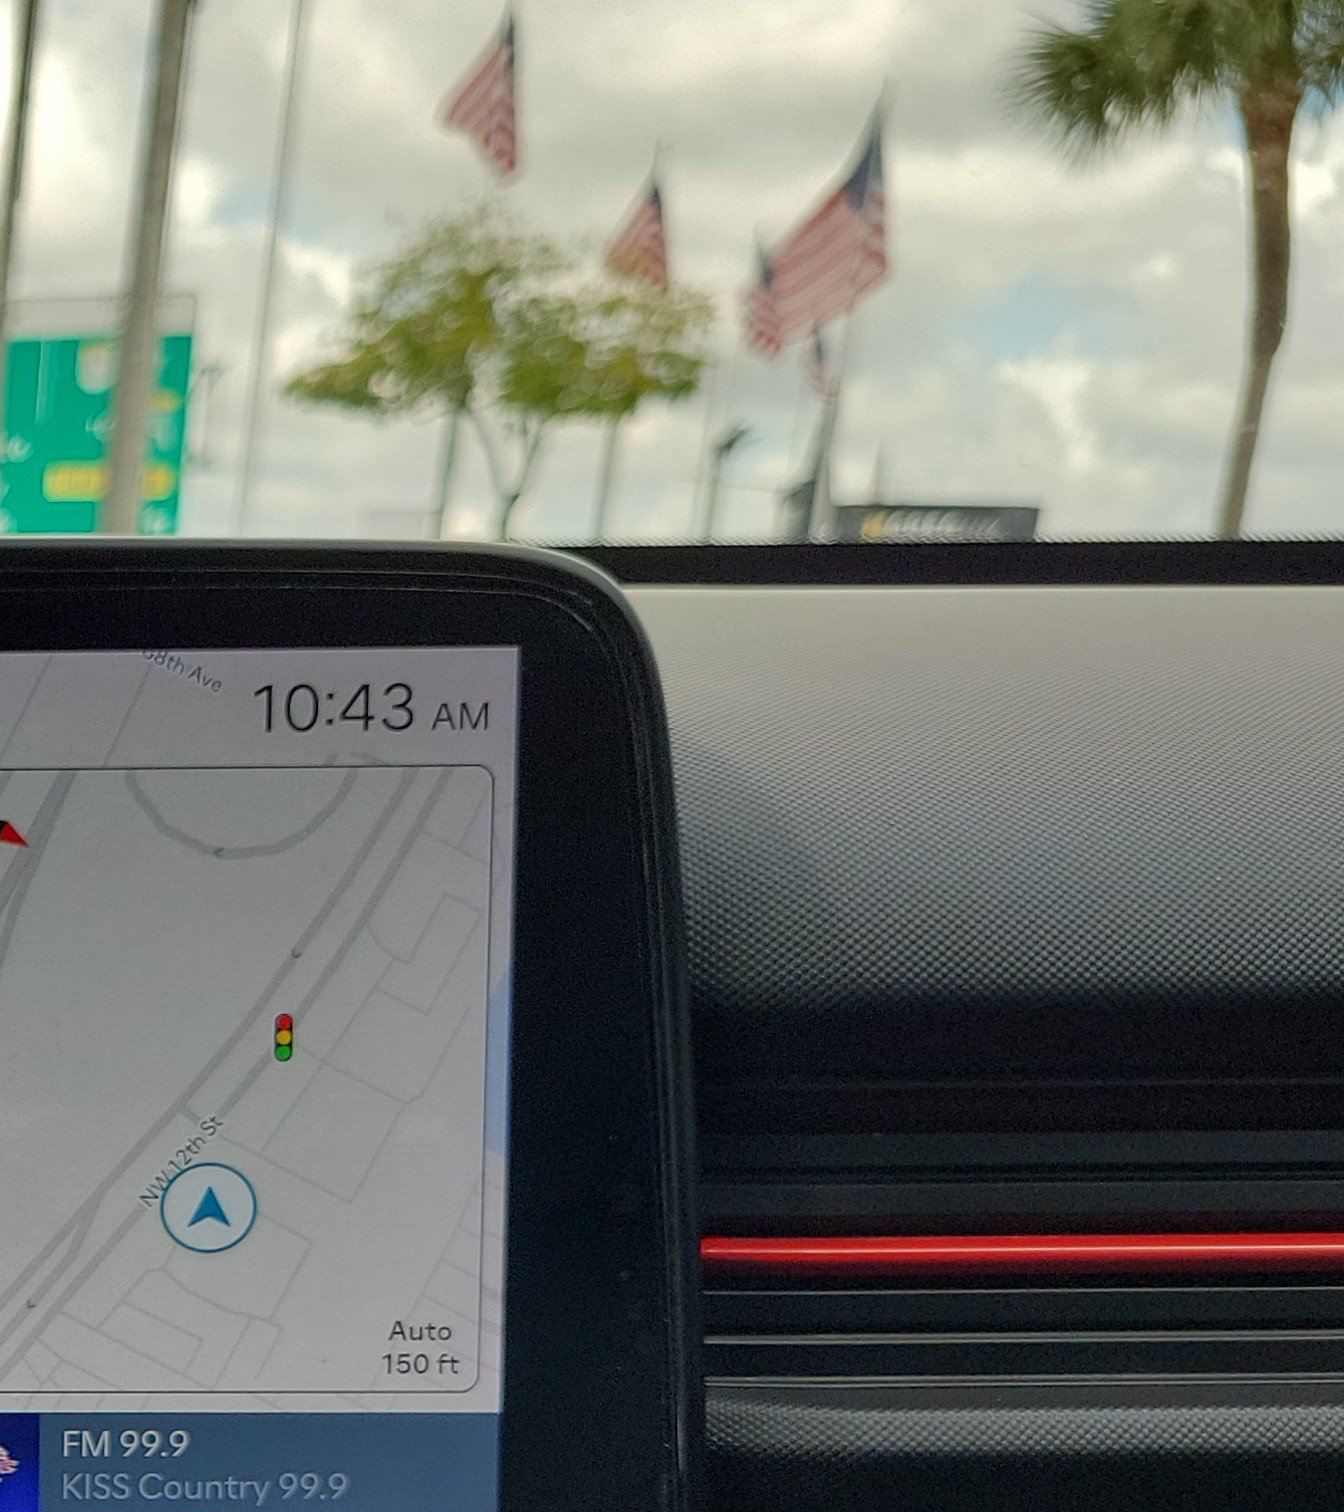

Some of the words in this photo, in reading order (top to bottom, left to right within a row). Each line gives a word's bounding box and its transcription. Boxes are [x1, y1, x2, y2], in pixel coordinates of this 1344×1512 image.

[187, 665, 222, 693] Ave
[253, 682, 414, 733] 10:43
[431, 702, 490, 731] AM
[167, 1132, 208, 1172] 12th
[198, 1113, 223, 1138] St
[388, 1321, 453, 1343] Auto
[382, 1353, 430, 1375] 150
[436, 1352, 460, 1375] ft
[62, 1431, 110, 1458] FM
[119, 1430, 189, 1458] 99.9
[62, 1474, 130, 1500] KISS
[138, 1473, 270, 1507] Country
[278, 1472, 349, 1501] 99.9
